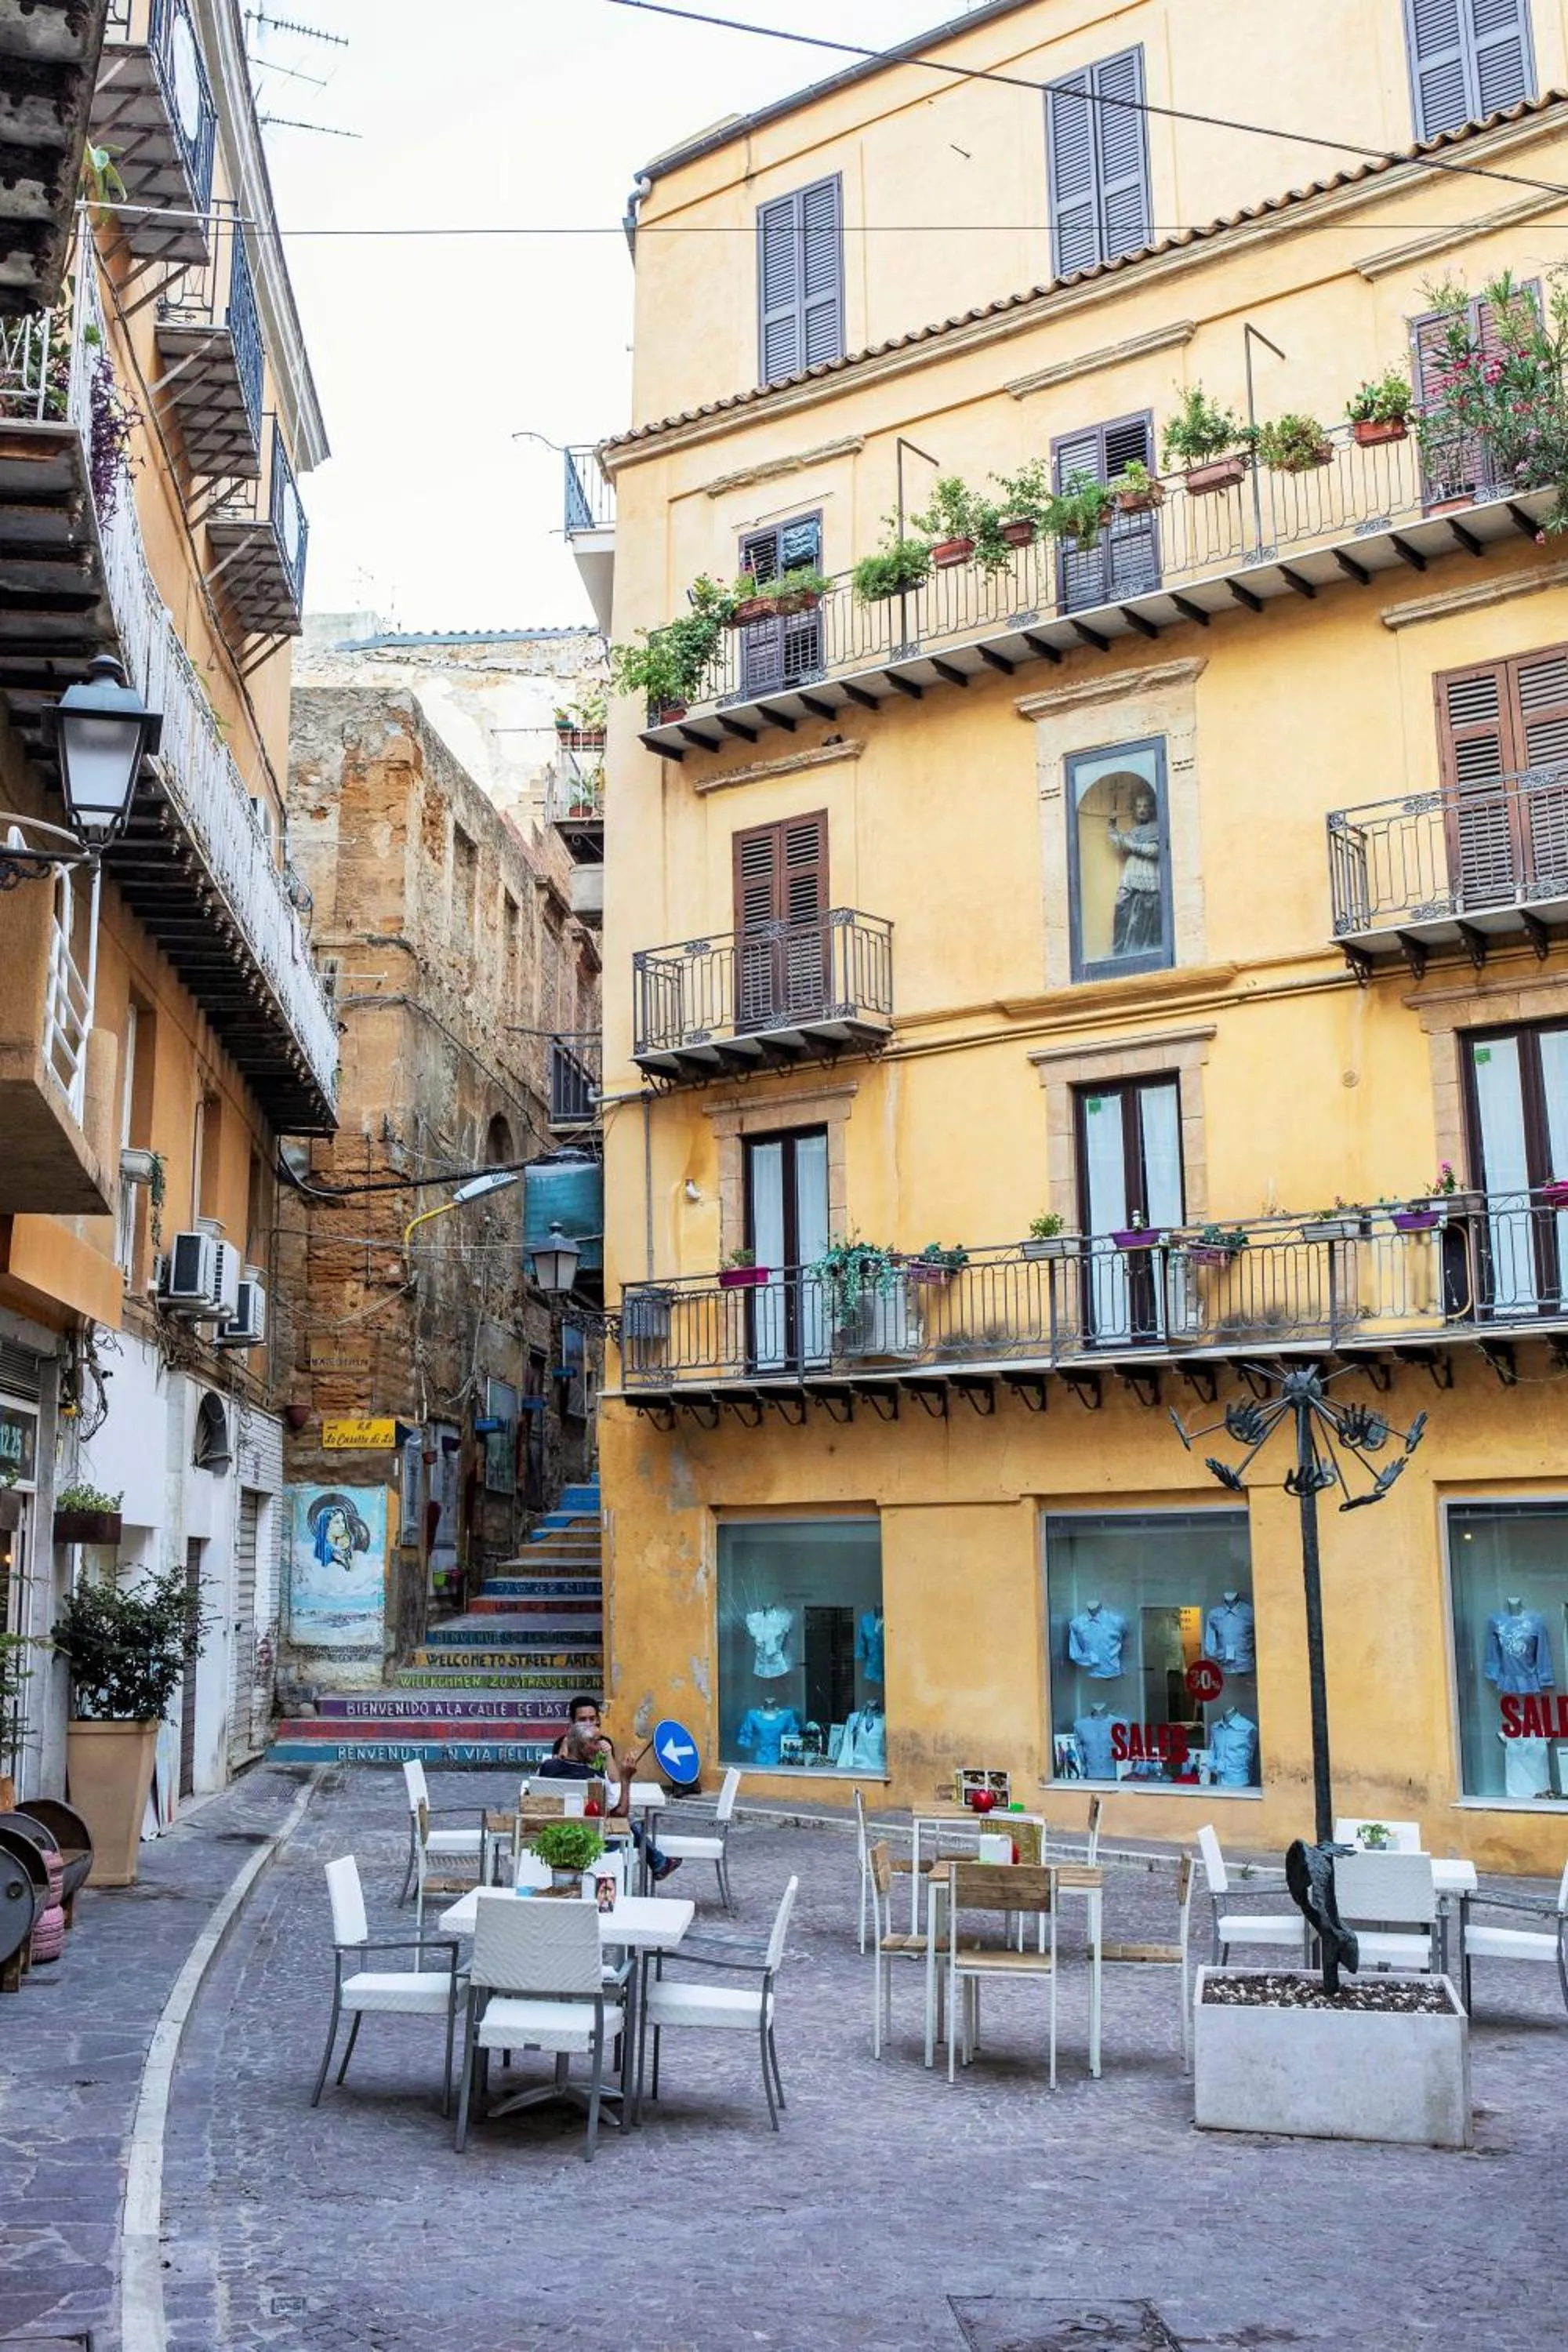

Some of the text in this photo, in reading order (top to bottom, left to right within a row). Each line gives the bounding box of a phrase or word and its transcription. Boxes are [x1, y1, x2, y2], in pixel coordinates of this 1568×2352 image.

[426, 1654, 487, 1667] WELCOME
[489, 1654, 506, 1667] TO
[508, 1653, 555, 1668] STREET
[346, 1702, 429, 1716] BIENVENIDO
[434, 1703, 444, 1715] A
[446, 1703, 462, 1715] LA
[468, 1704, 508, 1716] CALLE
[539, 1703, 563, 1717] LAS
[338, 1746, 428, 1760] BENVENUTI
[463, 1748, 491, 1760] VIA
